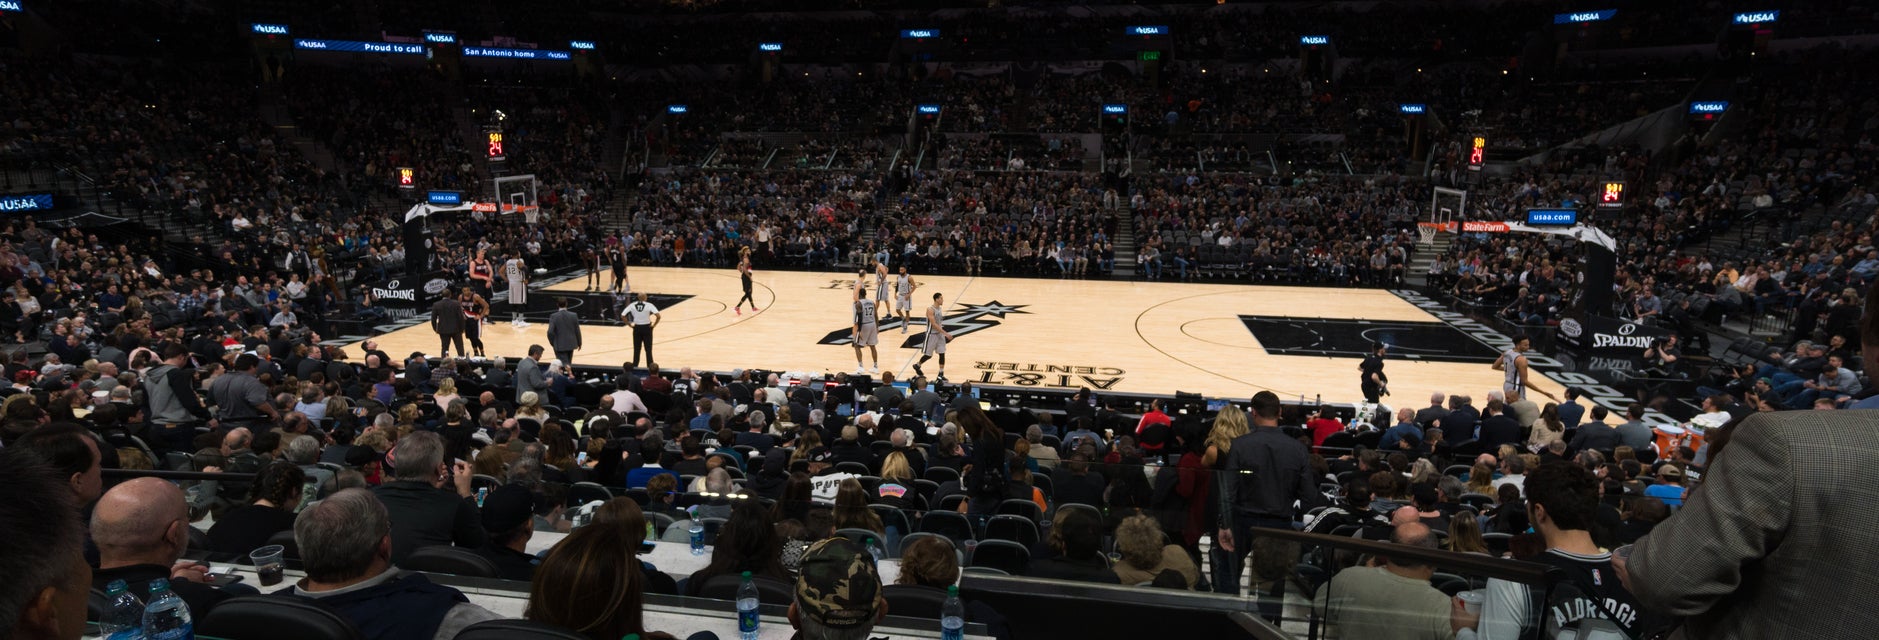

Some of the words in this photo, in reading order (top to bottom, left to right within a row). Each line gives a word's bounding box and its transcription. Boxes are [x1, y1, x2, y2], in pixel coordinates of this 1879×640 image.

[0, 1, 19, 10] SAA
[1580, 12, 1600, 21] USAA
[1749, 13, 1774, 22] USAA
[365, 43, 391, 51] Proud
[490, 142, 502, 156] 24
[1472, 147, 1482, 163] 24
[1604, 191, 1618, 201] 24
[4, 199, 37, 209] USAA
[373, 288, 415, 301] SPALDING
[1390, 289, 1447, 309] SAN
[864, 307, 874, 316] 17
[1593, 333, 1655, 348] SPALDIN
[974, 361, 1126, 375] CENTER
[966, 371, 1125, 390] AT&T
